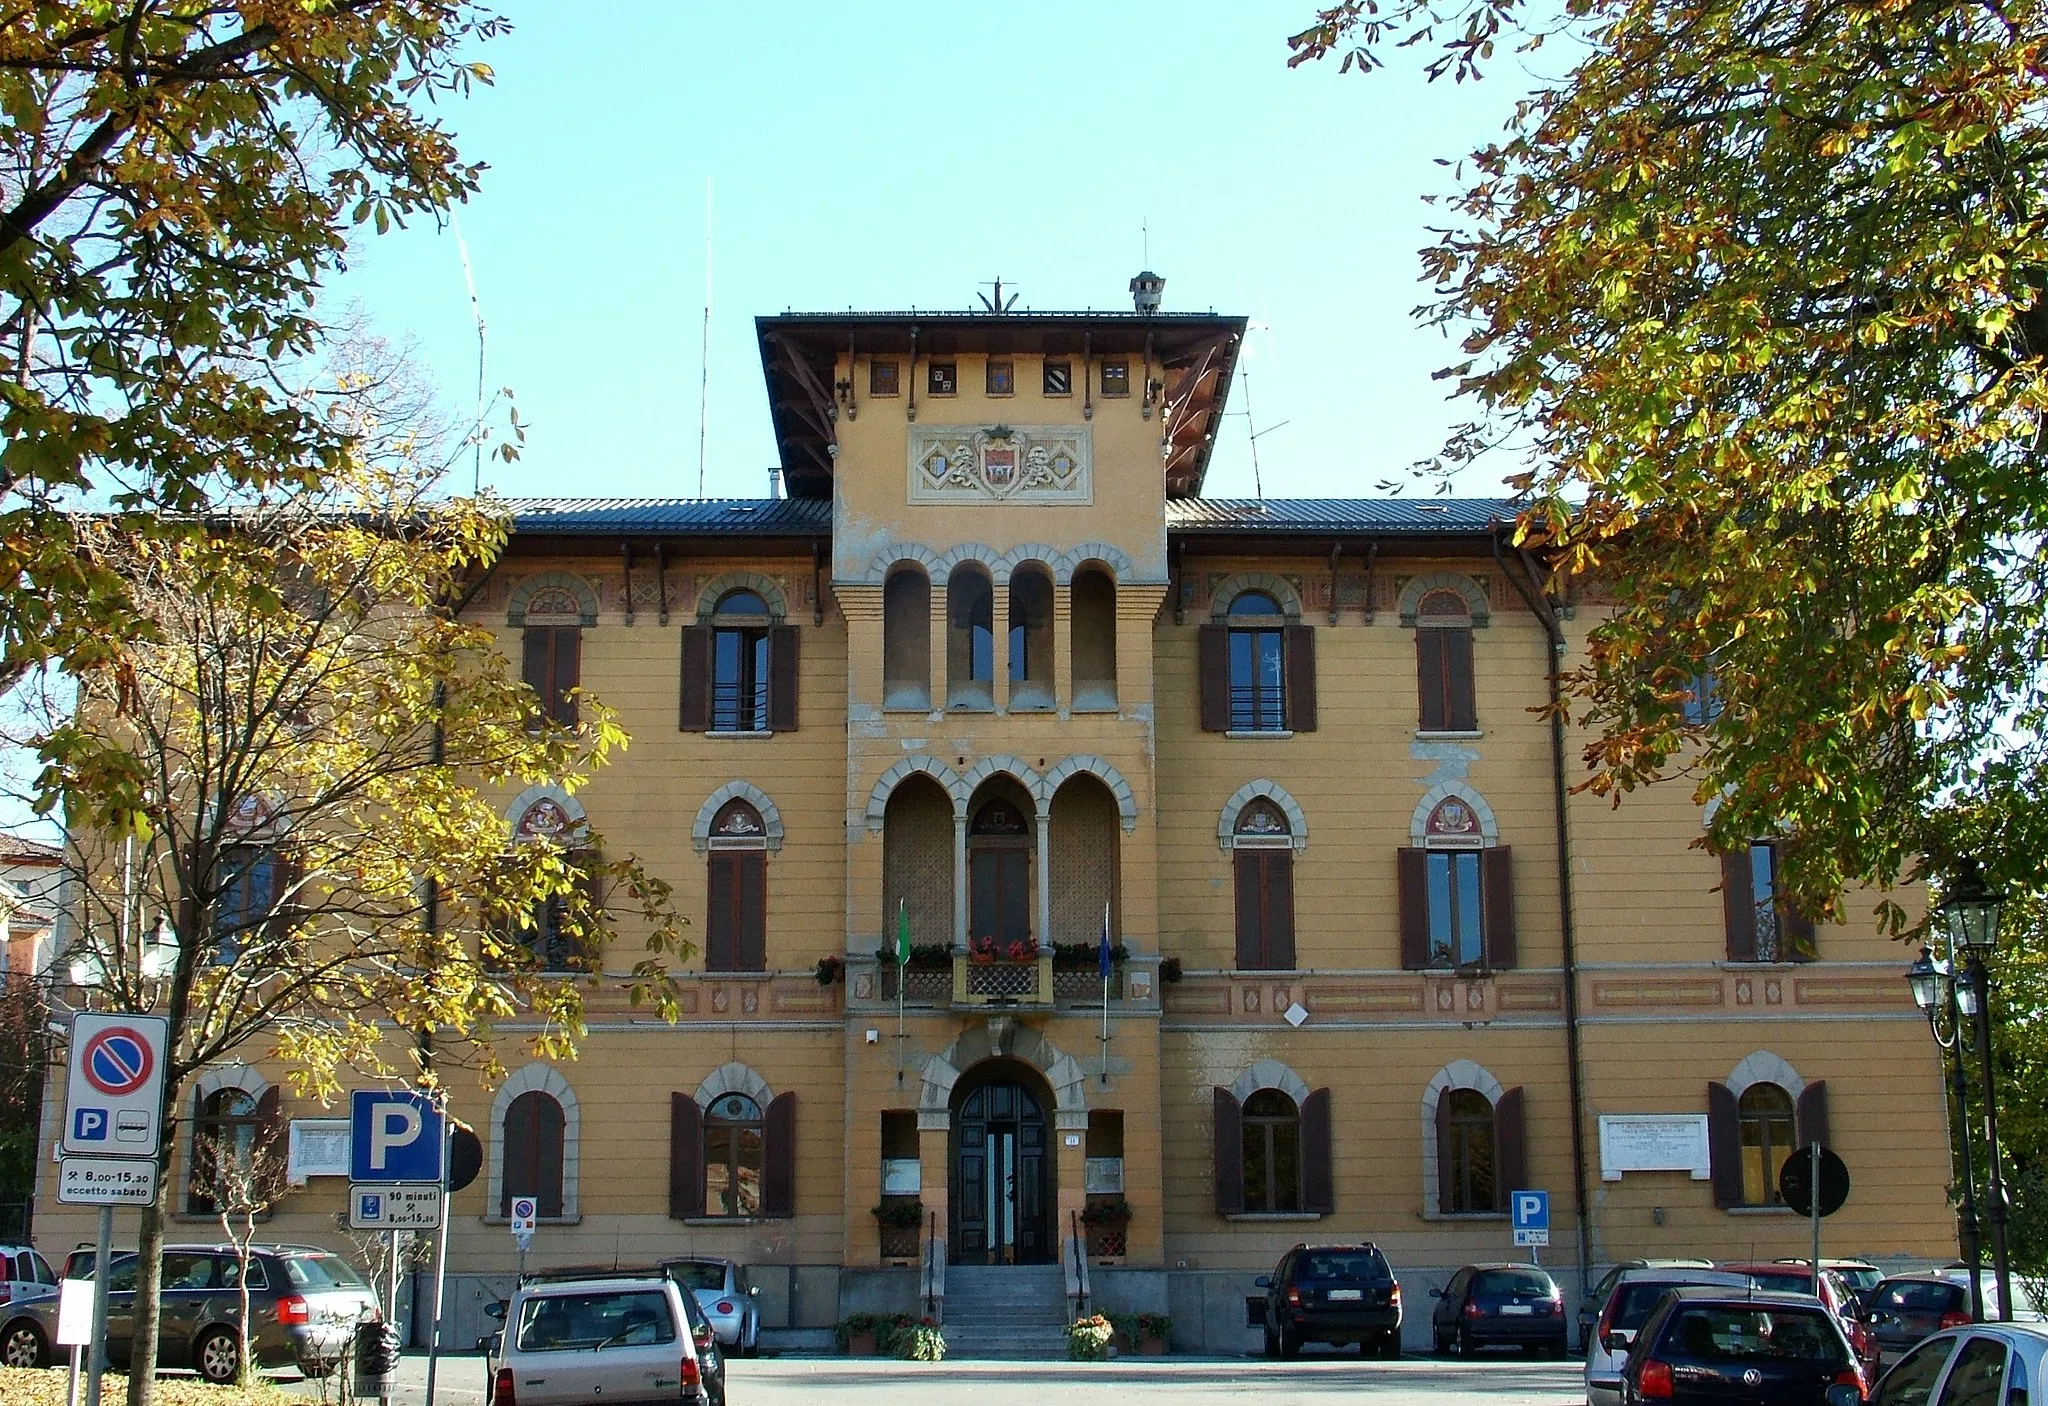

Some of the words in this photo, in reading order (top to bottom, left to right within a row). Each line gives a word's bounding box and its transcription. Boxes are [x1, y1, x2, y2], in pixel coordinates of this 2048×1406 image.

[81, 1112, 102, 1137] P
[370, 1103, 422, 1169] P
[66, 1186, 108, 1195] eccetto
[110, 1187, 148, 1197] sabato
[389, 1191, 402, 1201] 90
[405, 1191, 437, 1201] minuti
[1520, 1196, 1541, 1224] P
